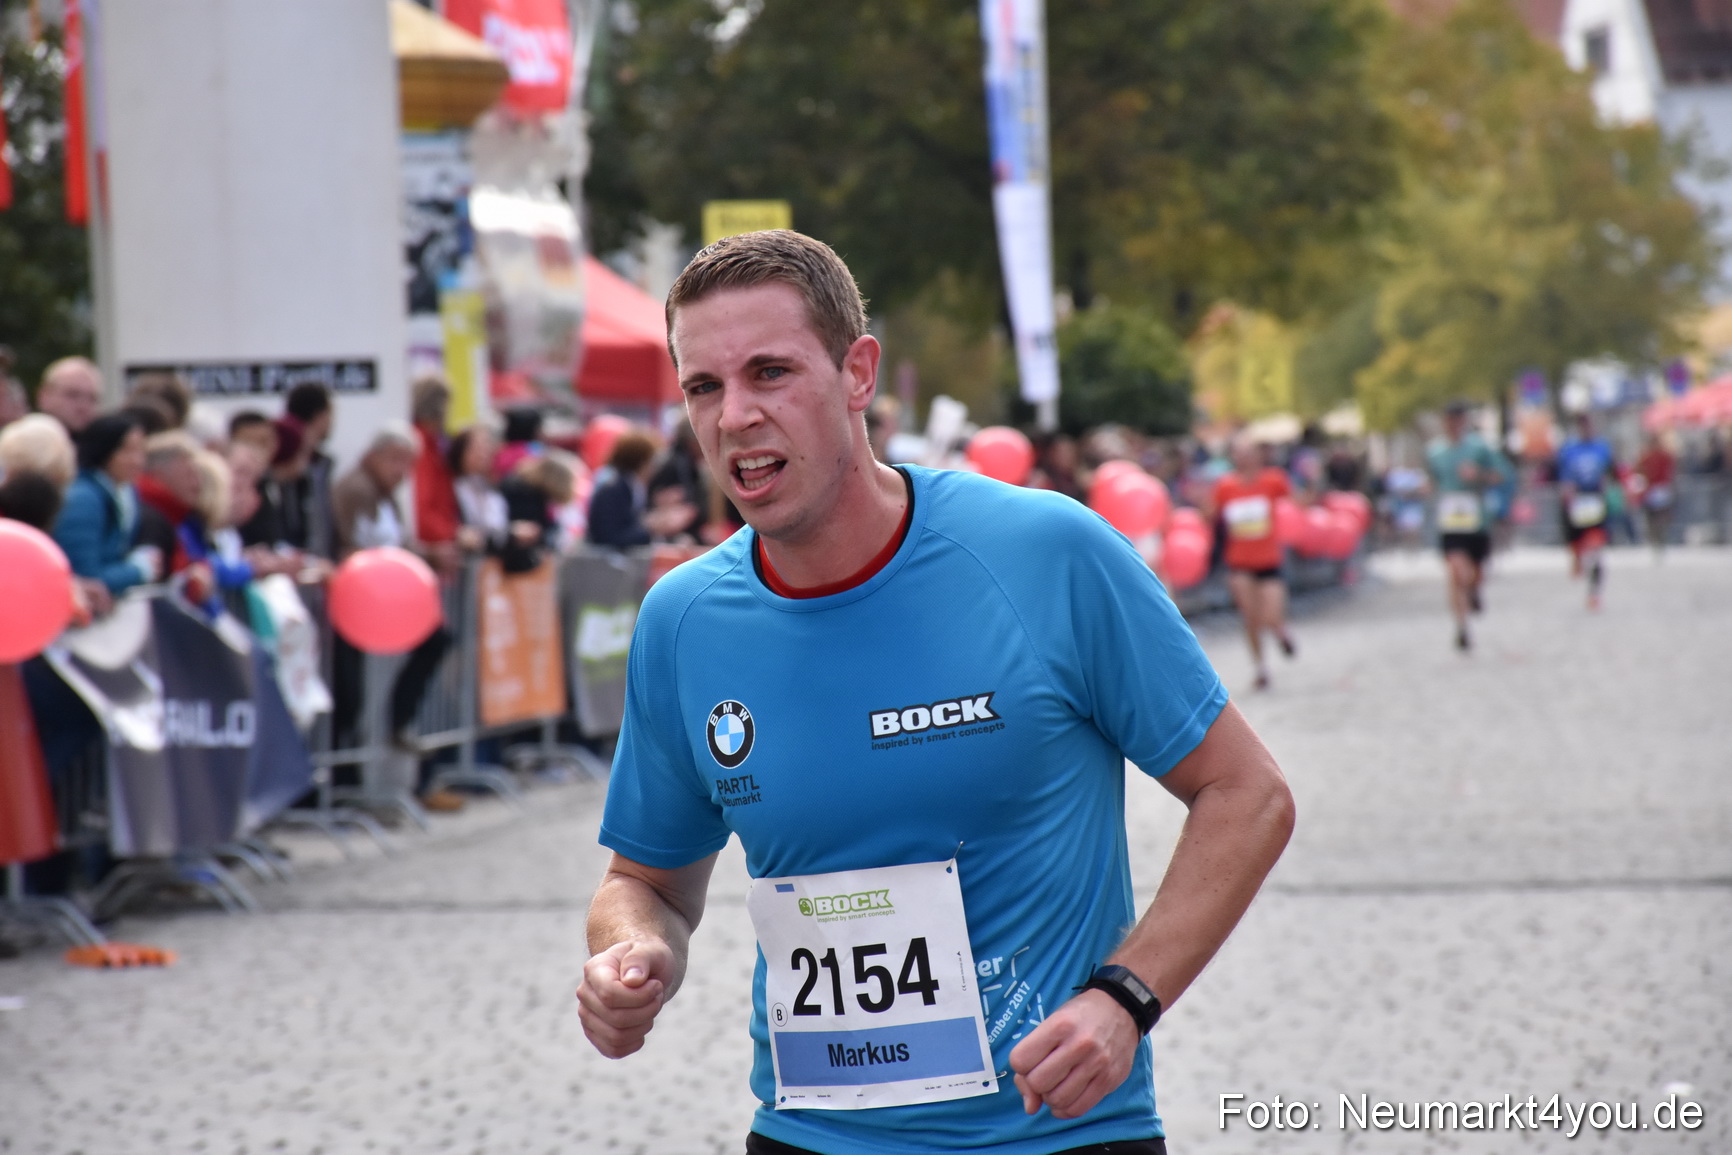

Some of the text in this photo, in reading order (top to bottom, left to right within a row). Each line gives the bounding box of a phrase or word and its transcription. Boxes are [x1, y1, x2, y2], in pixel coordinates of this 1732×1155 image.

[709, 702, 750, 727] BMW
[870, 693, 998, 738] BOCK
[871, 722, 1006, 750] inspired by smart concepts
[716, 774, 760, 795] PARTL
[721, 792, 762, 807] Neumarkt
[814, 889, 893, 916] BOCK
[848, 912, 867, 920] smart
[868, 909, 896, 917] concepts
[791, 937, 940, 1016] 2154
[977, 957, 1004, 977] er
[776, 1008, 783, 1021] B
[987, 981, 1031, 1044] ember 2017
[827, 1041, 910, 1068] Markus
